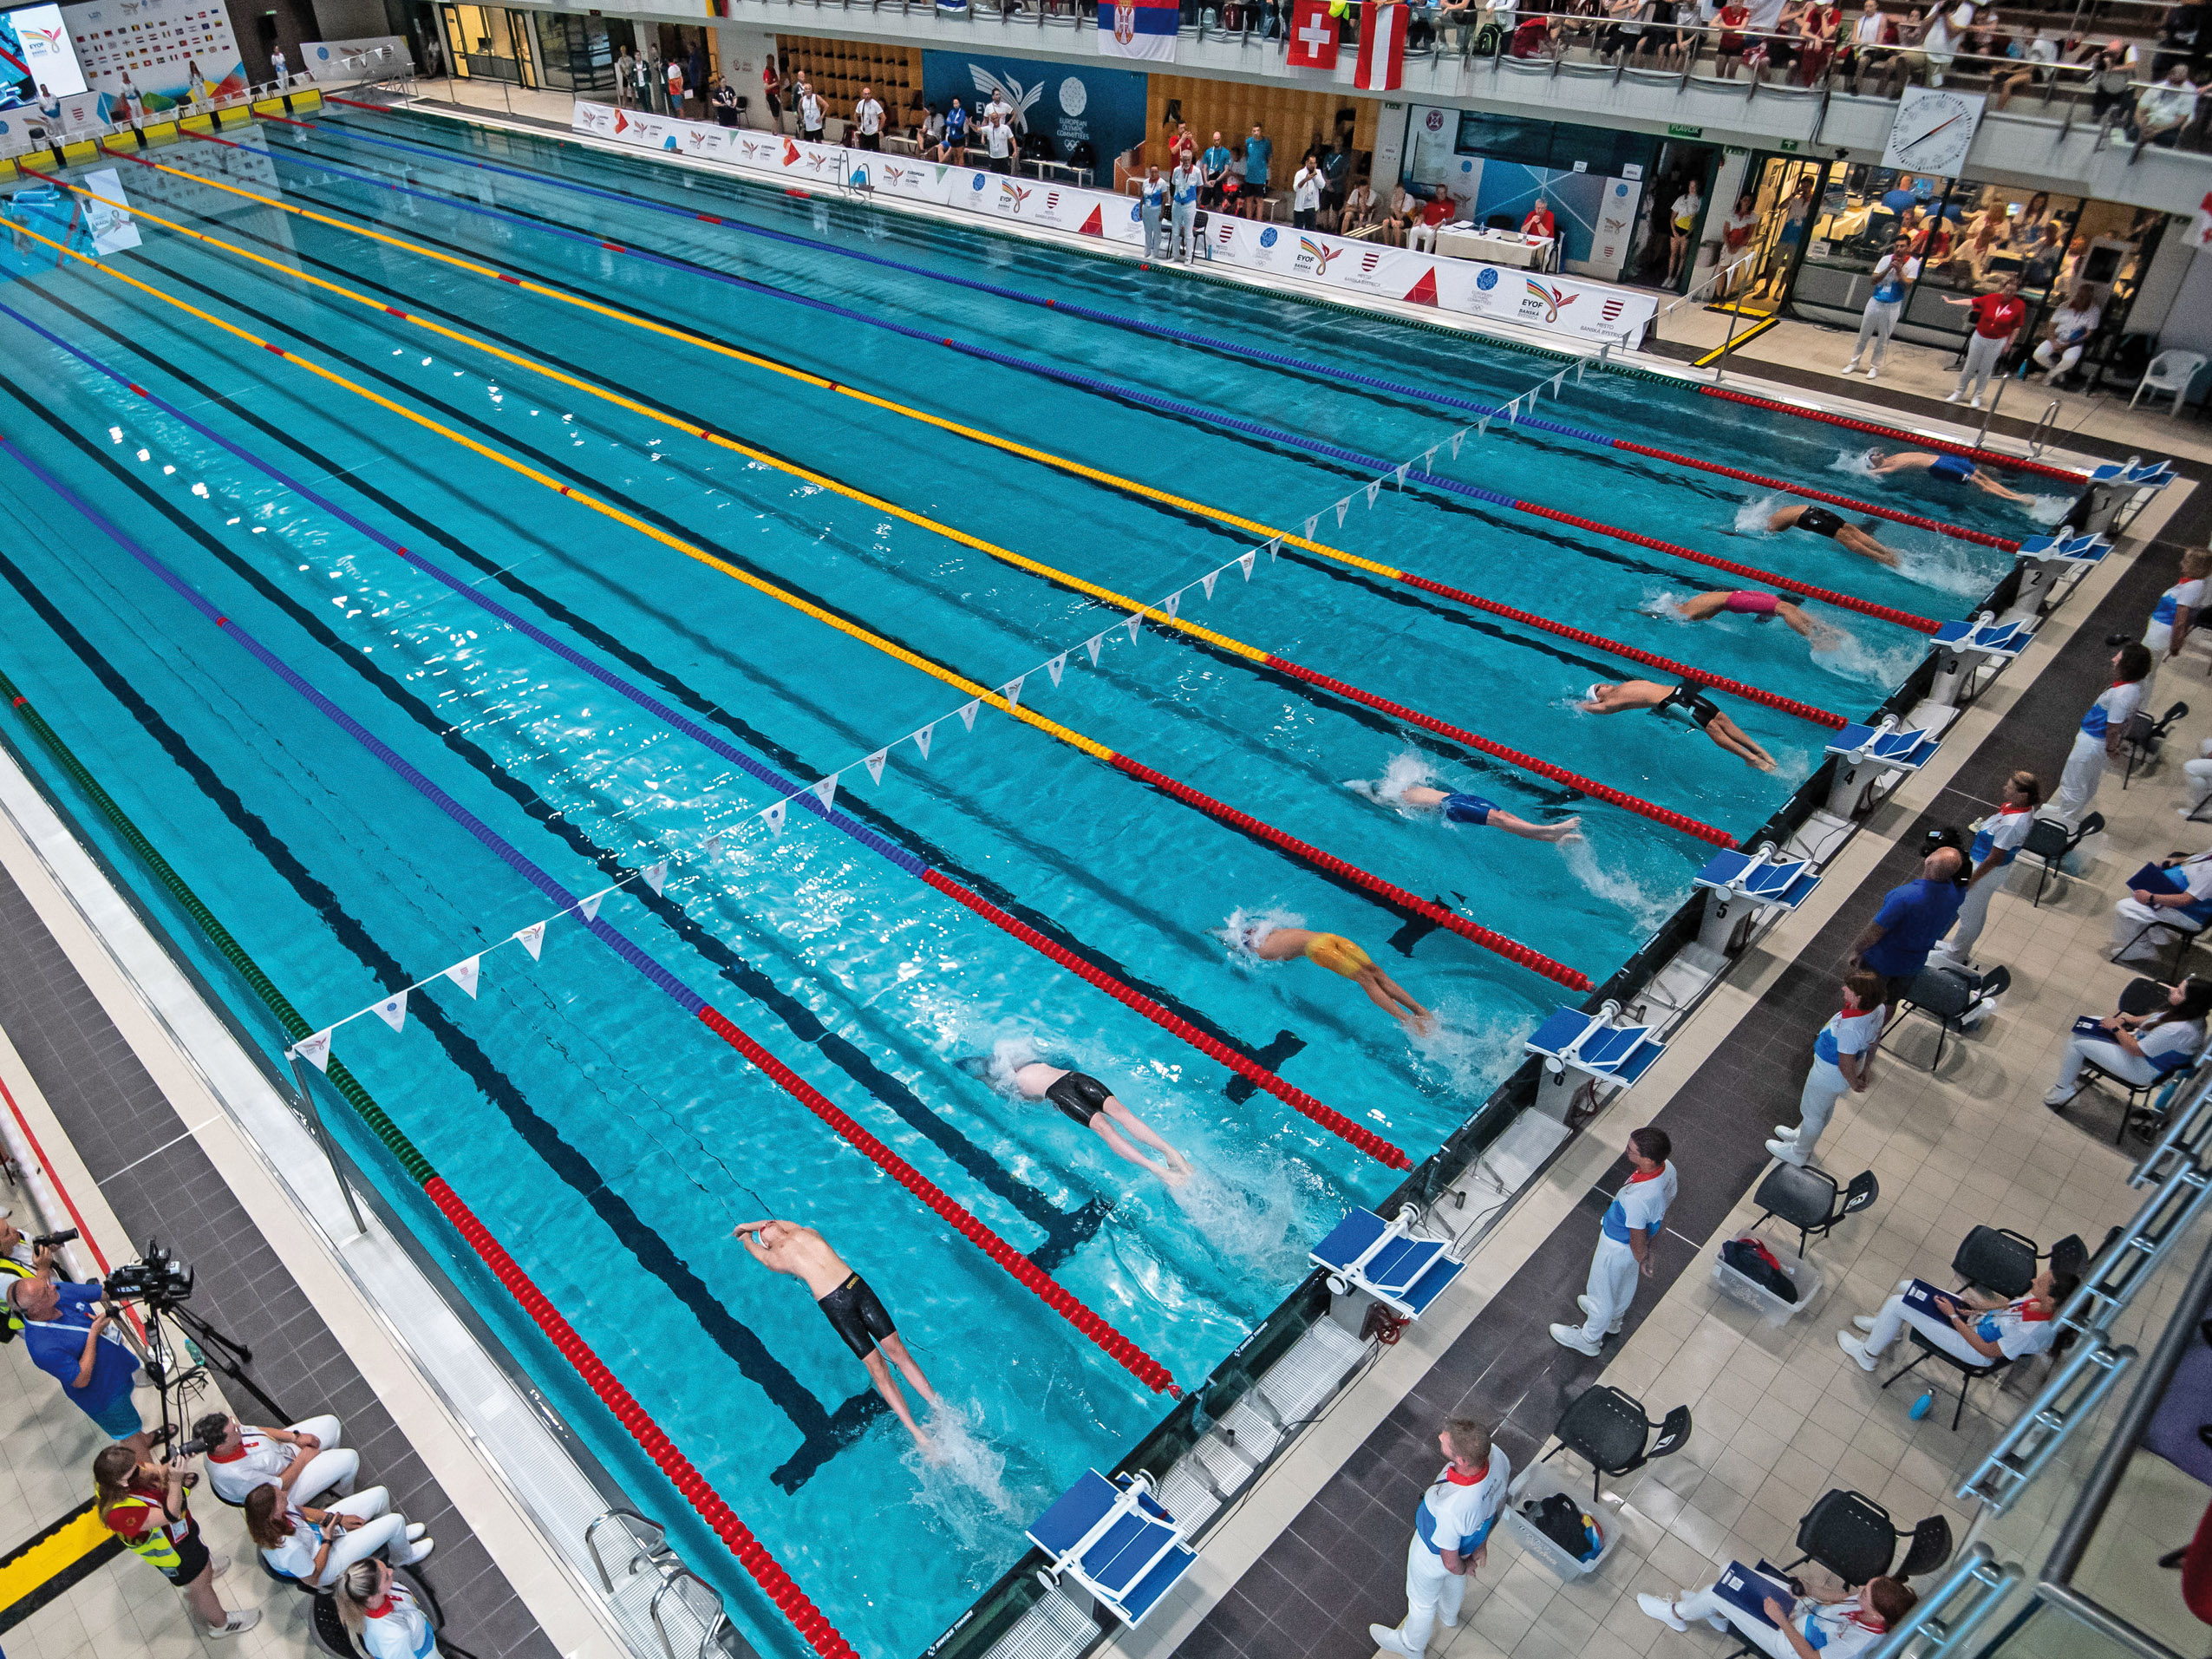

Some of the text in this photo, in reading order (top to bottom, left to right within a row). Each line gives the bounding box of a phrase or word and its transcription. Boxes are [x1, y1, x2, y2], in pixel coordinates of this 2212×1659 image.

[1059, 117, 1087, 127] EUROPEAN
[1057, 130, 1090, 140] COMMITTEES
[1296, 254, 1315, 263] EYOF
[1522, 298, 1543, 308] EYOF
[1518, 308, 1539, 317] BANSKÁ
[1580, 325, 1623, 339] BANSKÁ BYSTRIC
[2102, 497, 2111, 510] 1
[2031, 572, 2042, 585] 2
[1947, 660, 1958, 675] 3
[1844, 769, 1856, 785] 4
[1717, 903, 1729, 919] 5
[1553, 1070, 1566, 1087] 6
